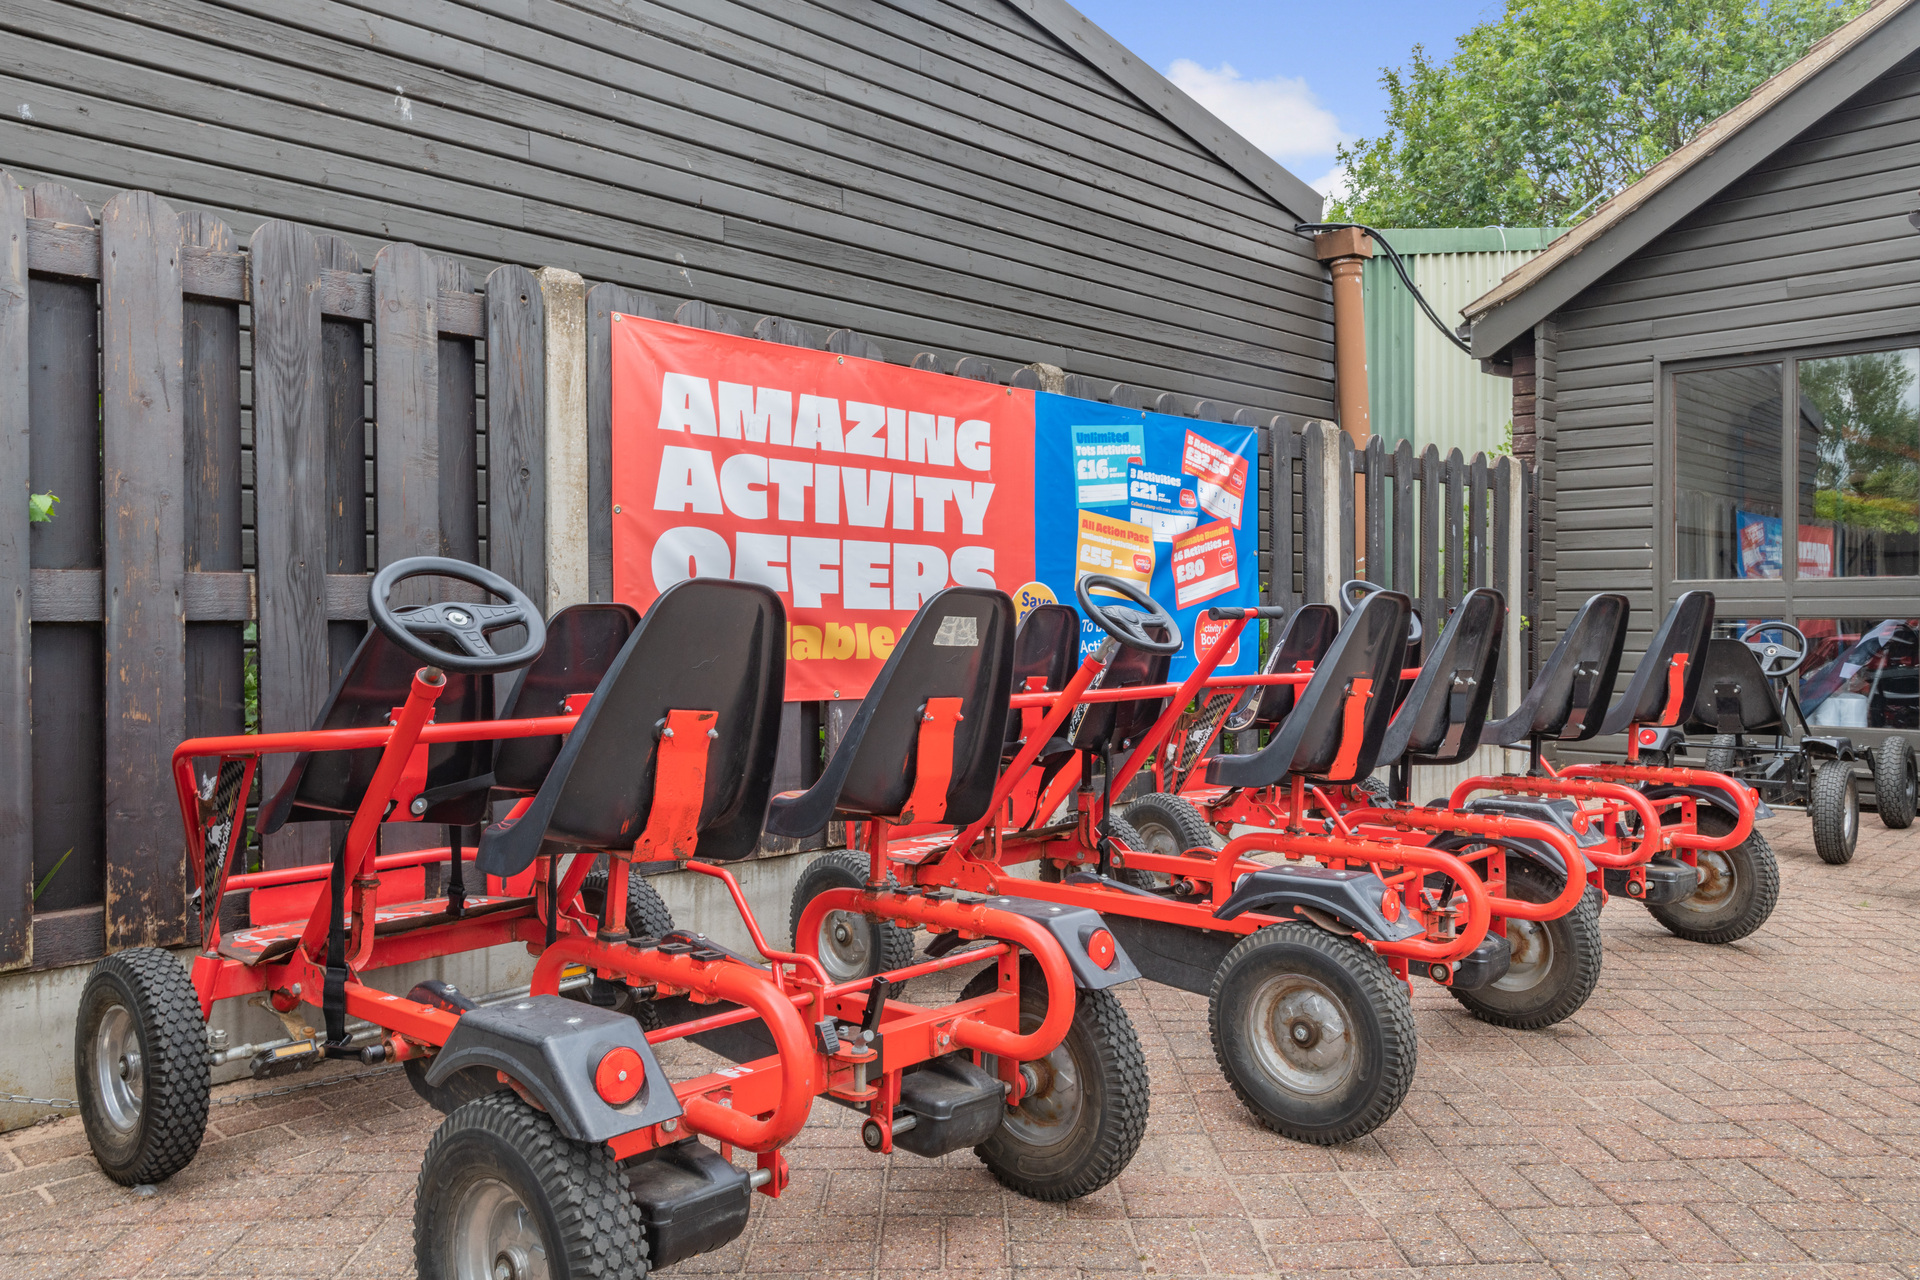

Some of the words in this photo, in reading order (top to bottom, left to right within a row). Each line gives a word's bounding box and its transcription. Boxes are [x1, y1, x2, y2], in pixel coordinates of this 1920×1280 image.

[657, 371, 991, 472] AMAZING
[1076, 431, 1130, 444] Unlimited
[1075, 445, 1096, 456] Tots
[1096, 444, 1141, 456] Activities
[1187, 434, 1194, 445] 5
[1193, 438, 1235, 465] Activities
[1130, 468, 1137, 479] 3
[1136, 469, 1181, 487] Activities
[653, 444, 996, 536] ACTIVITY
[1082, 519, 1095, 531] All
[1096, 522, 1126, 539] Action
[1127, 530, 1150, 544] Pass
[1204, 525, 1229, 540] Bundle
[1111, 539, 1140, 552] activities
[1173, 550, 1184, 563] 16
[1183, 538, 1222, 559] Activities
[651, 526, 997, 611] OFFERS
[1081, 619, 1094, 633] To
[1199, 621, 1222, 635] Activity
